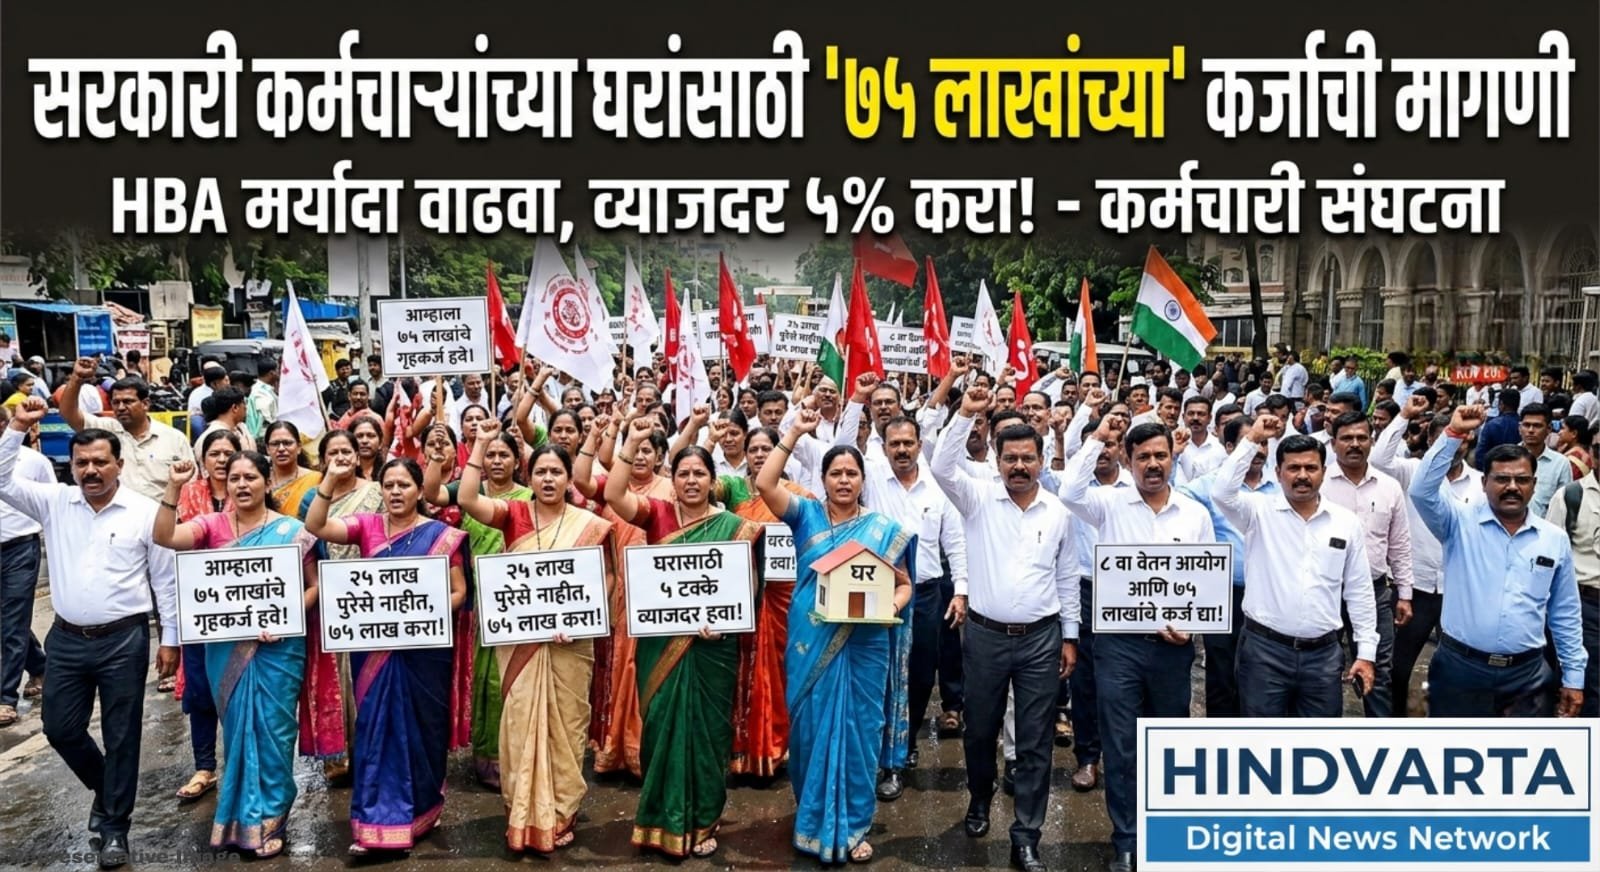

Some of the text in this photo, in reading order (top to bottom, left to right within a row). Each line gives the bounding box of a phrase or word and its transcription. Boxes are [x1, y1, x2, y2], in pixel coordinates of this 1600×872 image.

[398, 331, 418, 344] ७५
[398, 346, 445, 370] गृहकर्ज
[205, 557, 273, 578] आम्हाला
[507, 559, 575, 580] २५ लाख
[654, 549, 723, 572] घरासाठी
[1101, 551, 1227, 571] ८ वा वेतन आयोग
[351, 568, 419, 587] २५ लाख
[851, 565, 877, 581] घर
[195, 575, 286, 603] ७५ लाखांचे
[494, 581, 590, 613] पुरेसे नाहीत,
[661, 583, 672, 599] ५
[1128, 577, 1197, 597] आणि ७५
[337, 589, 434, 620] पुरेसे नाहीत,
[638, 603, 742, 625] व्याजदर हवा!
[1162, 602, 1194, 622] कर्ज
[1197, 606, 1223, 622] द्या!
[193, 604, 288, 635] गृहकर्ज हवे!
[329, 618, 444, 641] ७५ लाख करा!
[488, 608, 602, 634] ७५ लाख करा!
